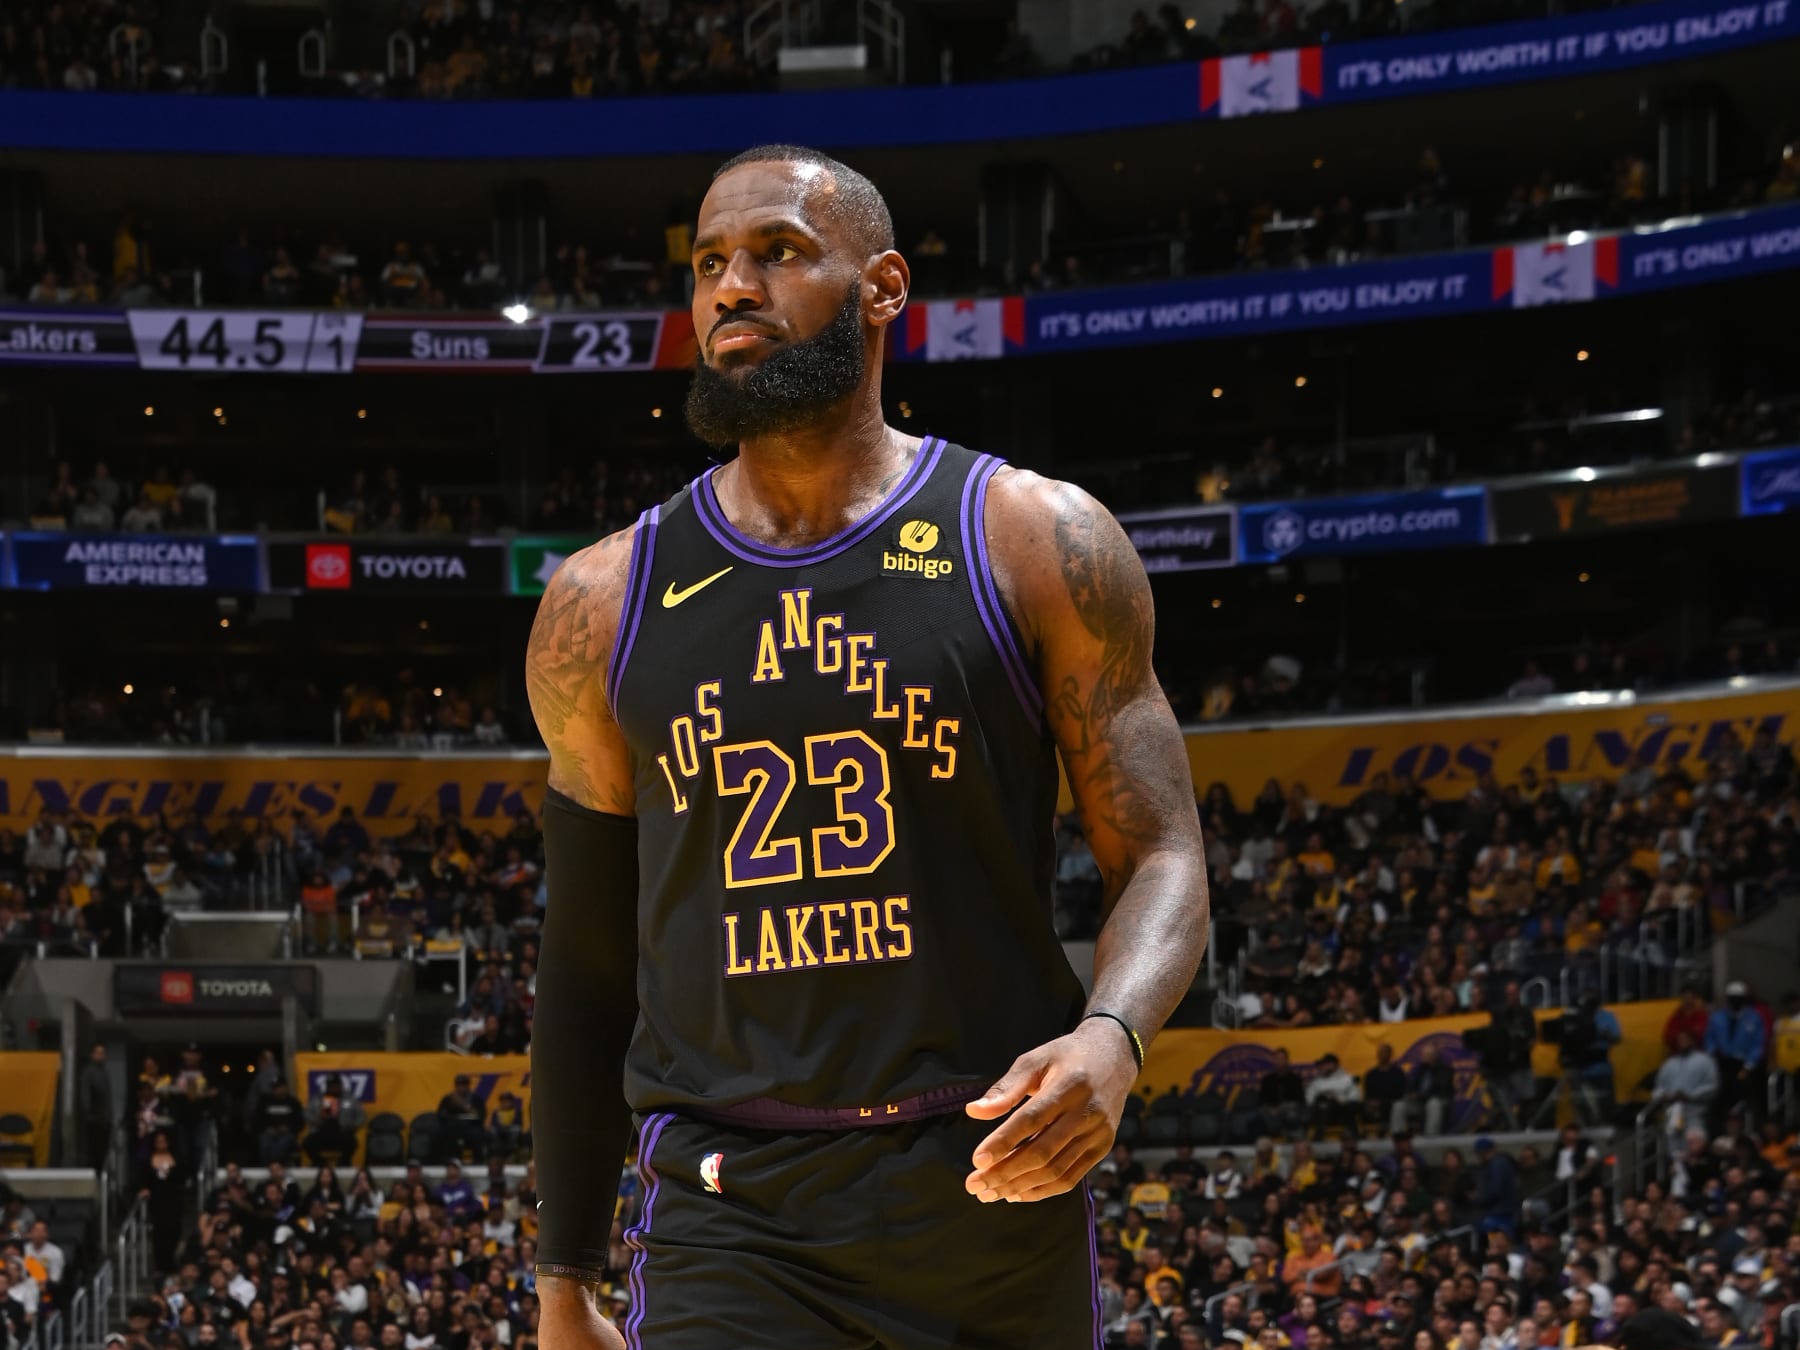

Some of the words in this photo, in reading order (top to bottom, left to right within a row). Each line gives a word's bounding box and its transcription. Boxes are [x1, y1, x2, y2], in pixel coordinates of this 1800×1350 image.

[1338, 61, 1381, 89] IT'S
[1387, 51, 1453, 83] ONLY
[1456, 40, 1551, 75] WORTH
[1556, 35, 1580, 62] IT
[1584, 32, 1609, 57] IF
[1614, 24, 1669, 54] YOU
[1674, 7, 1759, 44] ENJOY
[1764, 0, 1790, 26] IT
[1634, 248, 1679, 277] IT'S
[1682, 237, 1746, 269] ONLY
[1040, 311, 1081, 338] IT'S
[1086, 306, 1146, 333] ONLY
[1150, 299, 1238, 328] WORTH
[1243, 295, 1266, 319] IT
[1270, 292, 1293, 317] IF
[1298, 285, 1350, 314] YOU
[1355, 278, 1437, 308] ENJOY
[1443, 274, 1467, 299] IT
[160, 316, 285, 368] 44.5
[327, 334, 344, 368] 1
[410, 330, 490, 359] Suns
[571, 322, 633, 368] 23
[1307, 506, 1461, 543] crypto.com
[64, 541, 206, 564] AMERICAN
[358, 555, 467, 579] TOYOTA
[883, 551, 953, 579] bibigo
[85, 563, 208, 586] EXPRESS
[656, 679, 725, 815] LOS
[750, 587, 963, 781] ANGELES
[1337, 738, 1501, 787] LOS
[0, 779, 341, 817] NGELES
[712, 730, 896, 889] 23
[722, 894, 915, 978] LAKERS
[199, 979, 273, 997] TOYOTA
